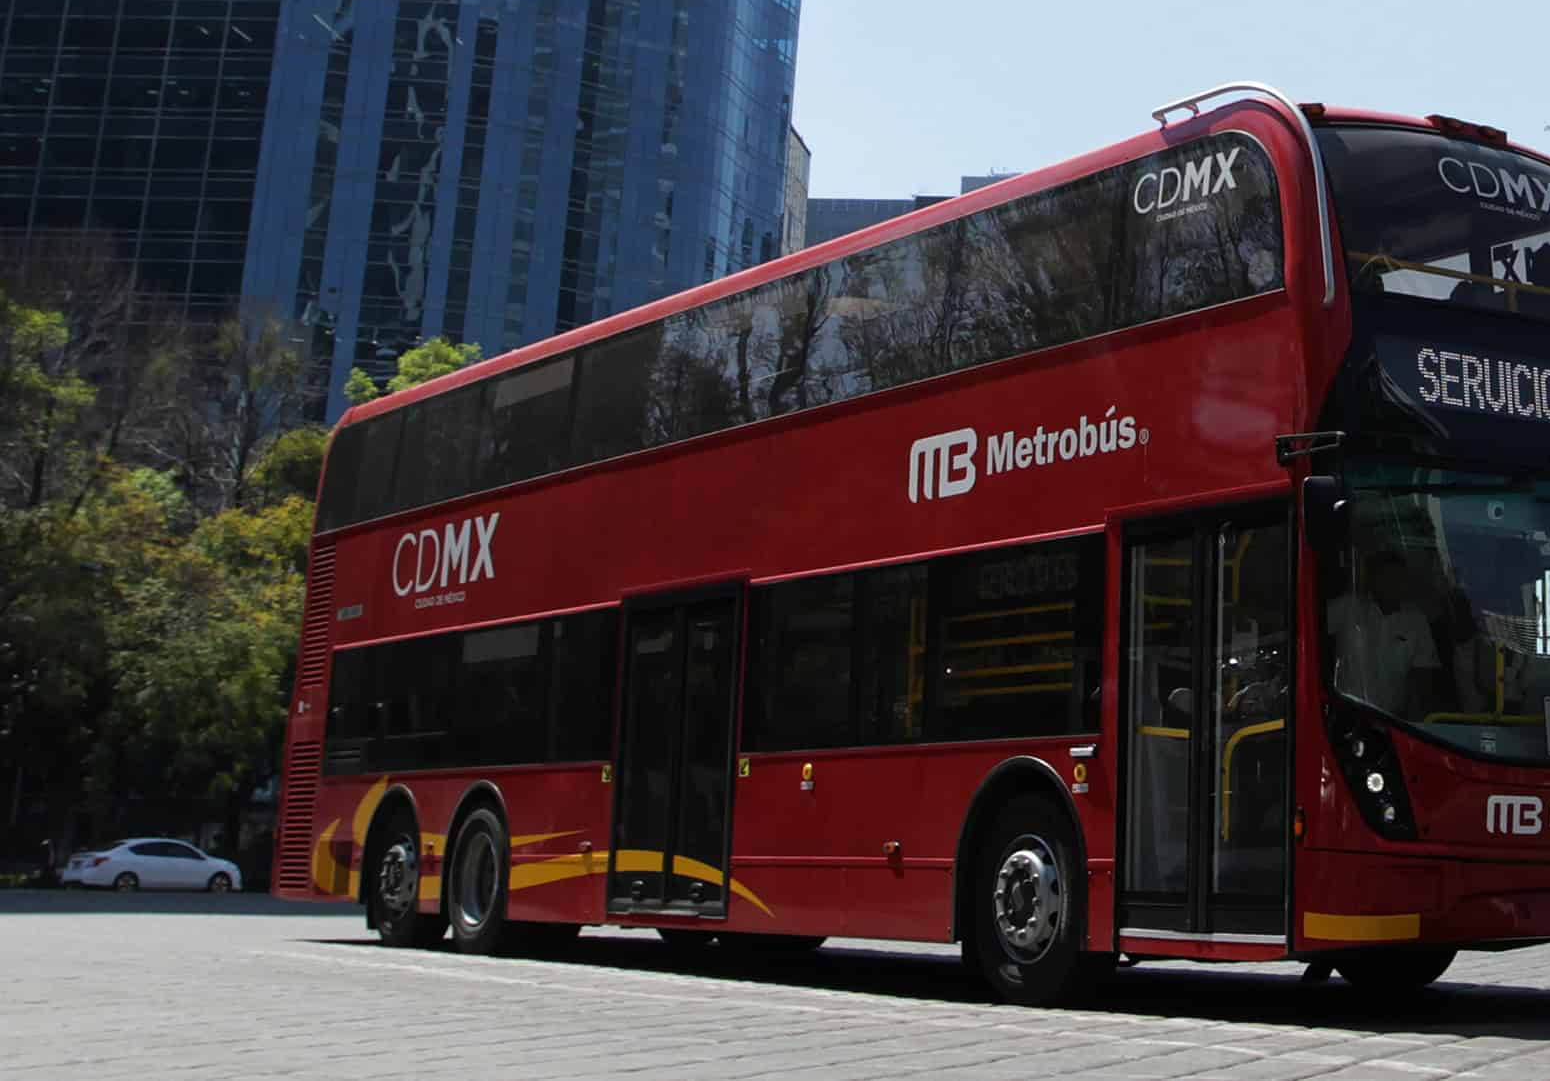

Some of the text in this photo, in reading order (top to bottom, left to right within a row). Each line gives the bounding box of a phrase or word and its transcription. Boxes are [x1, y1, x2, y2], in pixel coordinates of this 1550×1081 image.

[1134, 147, 1240, 214] CDMX
[986, 405, 1137, 477] Metrobús
[392, 512, 500, 597] CDMX
